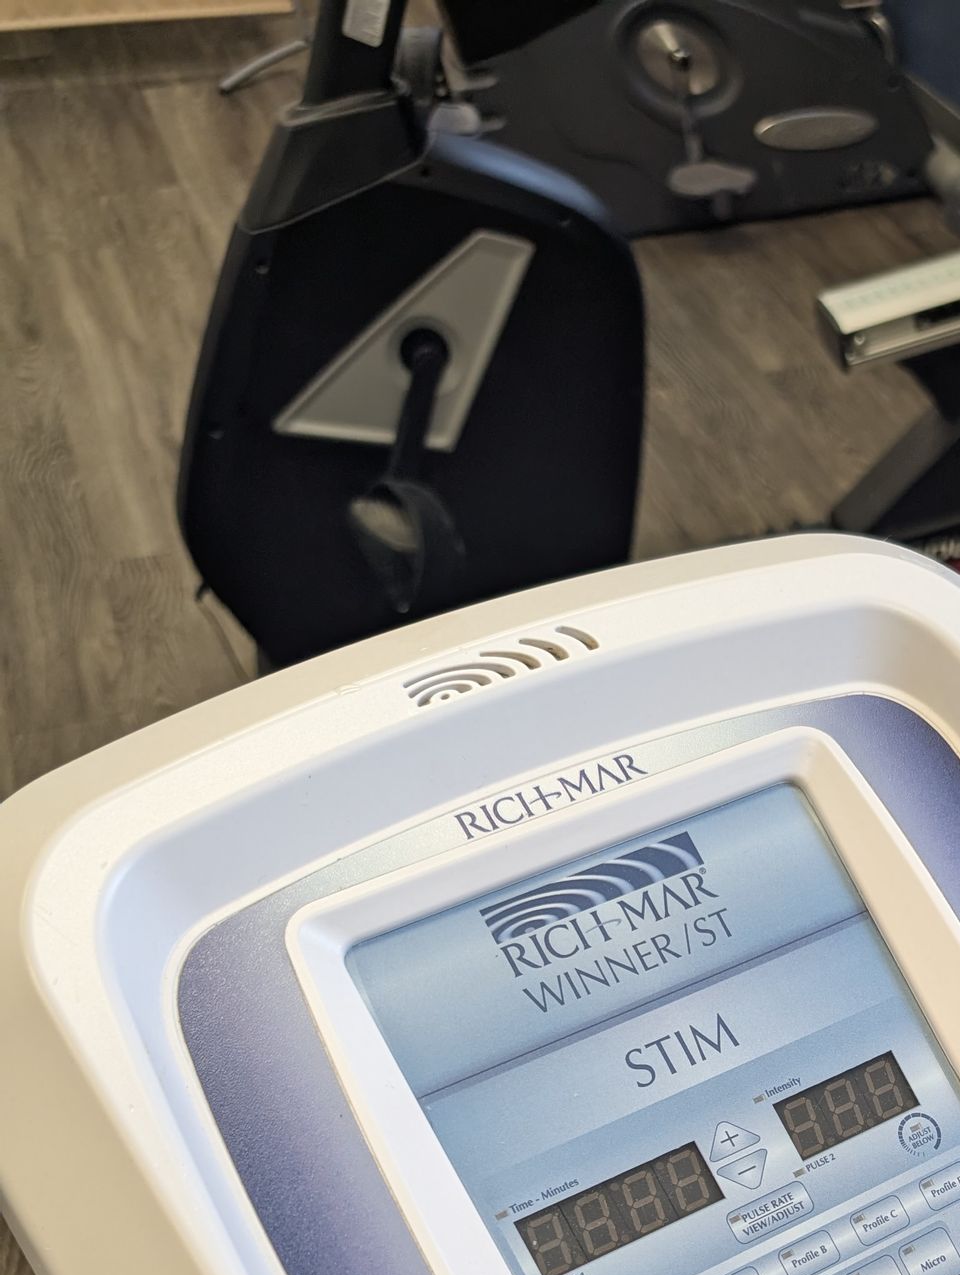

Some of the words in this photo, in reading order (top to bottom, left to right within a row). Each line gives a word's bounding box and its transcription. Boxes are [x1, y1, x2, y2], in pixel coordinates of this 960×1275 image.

[455, 754, 648, 840] RICH-MAR
[625, 1013, 740, 1088] STIM
[764, 1077, 801, 1098] Intensity
[908, 1127, 932, 1142] ADJUST
[912, 1133, 935, 1149] BELOW
[806, 1157, 830, 1173] PULSE
[830, 1153, 836, 1161] 2
[509, 1198, 534, 1215] Time
[541, 1178, 580, 1200] Minutes
[931, 1180, 957, 1198] Profile
[741, 1202, 770, 1223] PULSE
[770, 1192, 794, 1208] RATE
[743, 1201, 805, 1236] VIEW/ADJUST
[862, 1215, 889, 1233] Profile
[890, 1209, 899, 1218] C
[791, 1250, 820, 1268] Profile
[820, 1245, 828, 1254] B
[920, 1255, 947, 1272] Micro
